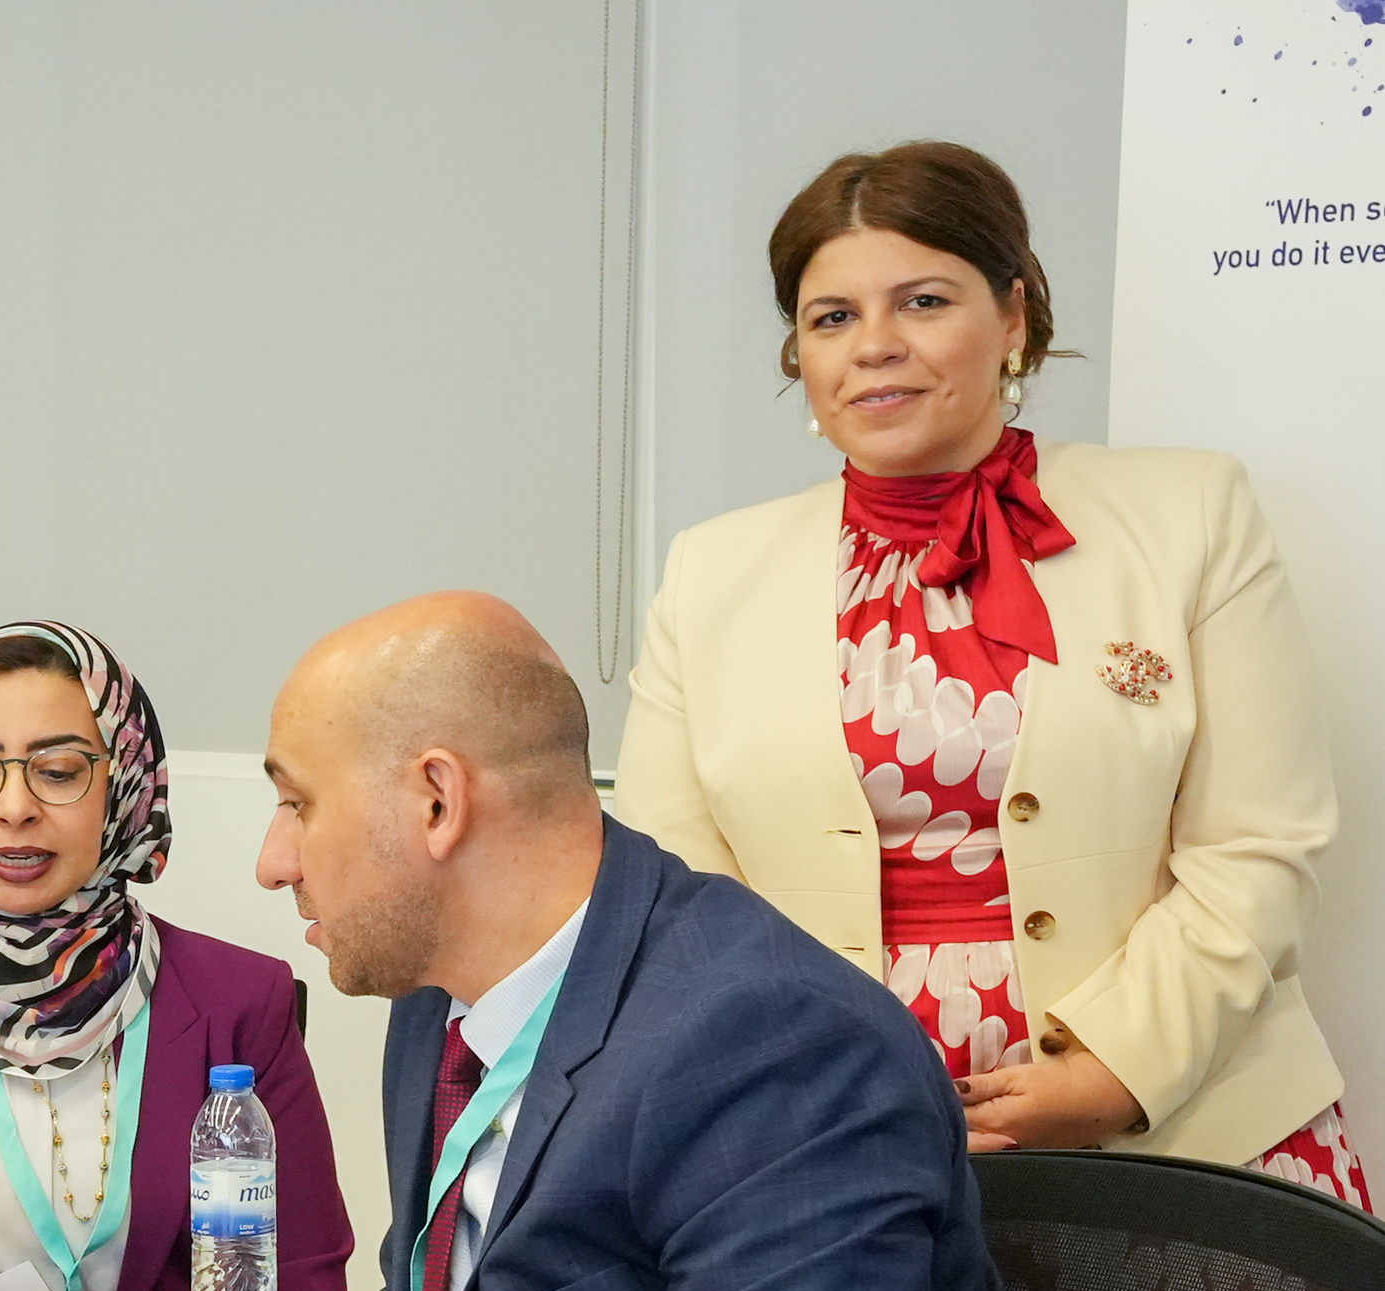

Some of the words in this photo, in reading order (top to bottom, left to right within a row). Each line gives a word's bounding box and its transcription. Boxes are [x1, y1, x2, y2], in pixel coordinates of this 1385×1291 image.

[1365, 201, 1385, 221] s
[1213, 248, 1261, 277] you
[1271, 240, 1304, 267] do
[1313, 239, 1330, 266] it
